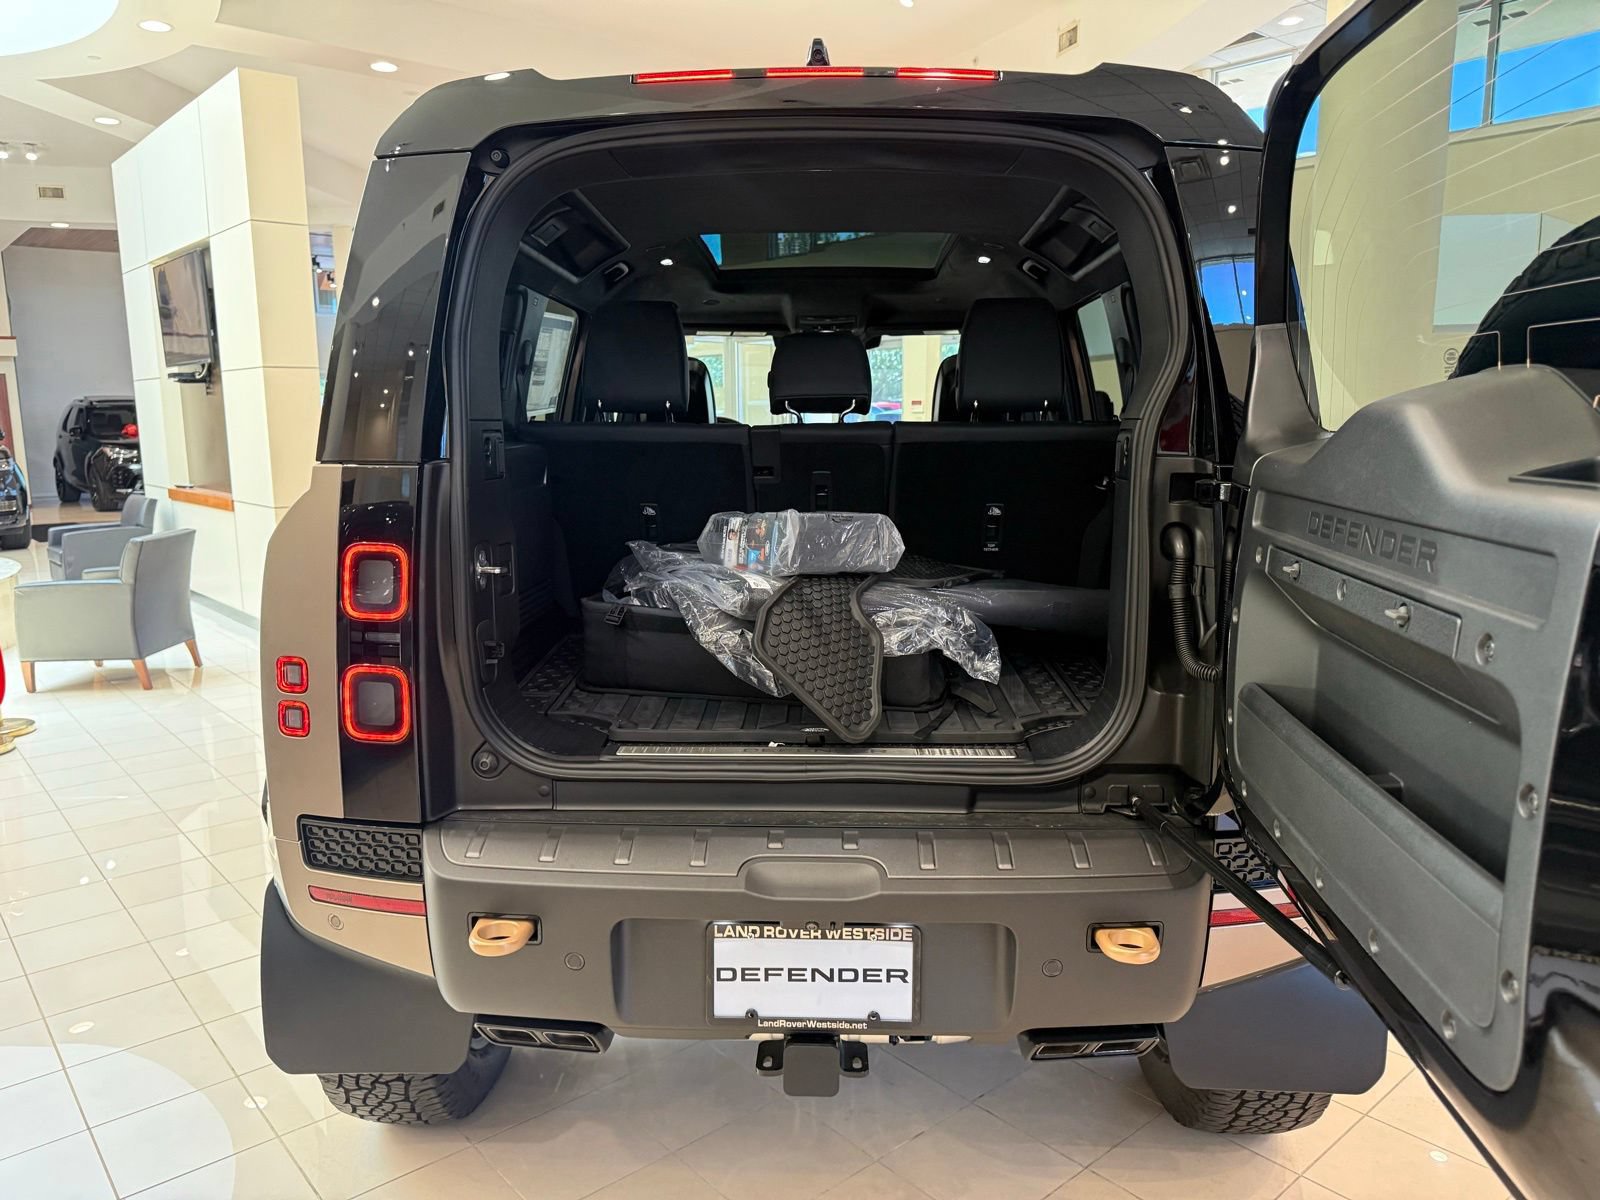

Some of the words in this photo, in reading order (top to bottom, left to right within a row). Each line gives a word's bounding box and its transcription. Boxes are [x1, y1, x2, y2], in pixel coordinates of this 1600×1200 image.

[1307, 511, 1437, 573] DEFENDER
[714, 924, 760, 938] LAND
[763, 925, 821, 939] ROVER
[825, 927, 913, 941] WESTSIDE
[716, 967, 909, 983] DEFENDER
[757, 1019, 868, 1030] LandRoverWestside.net
